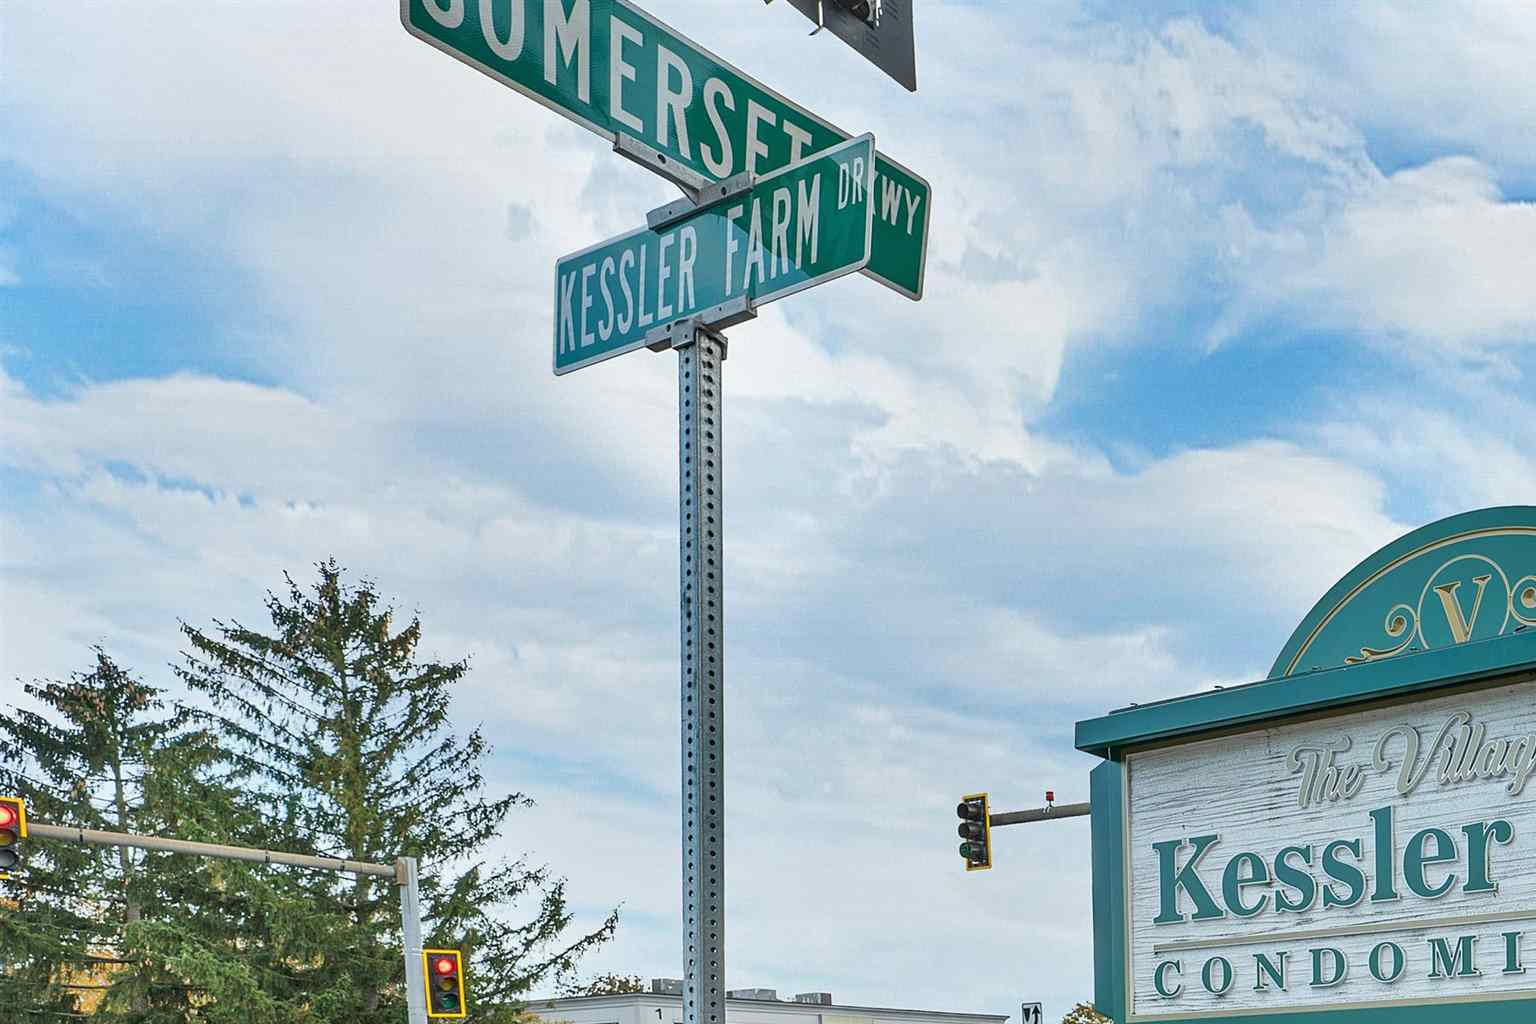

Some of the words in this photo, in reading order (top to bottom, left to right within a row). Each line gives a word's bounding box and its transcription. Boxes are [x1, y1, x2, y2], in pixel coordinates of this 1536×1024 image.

[422, 0, 812, 180] OMERSET
[559, 224, 697, 355] KESSLER
[724, 173, 821, 297] FARM
[837, 156, 864, 210] DR
[1433, 574, 1492, 644] V
[1286, 736, 1366, 808] The
[1151, 805, 1514, 925] Kessler
